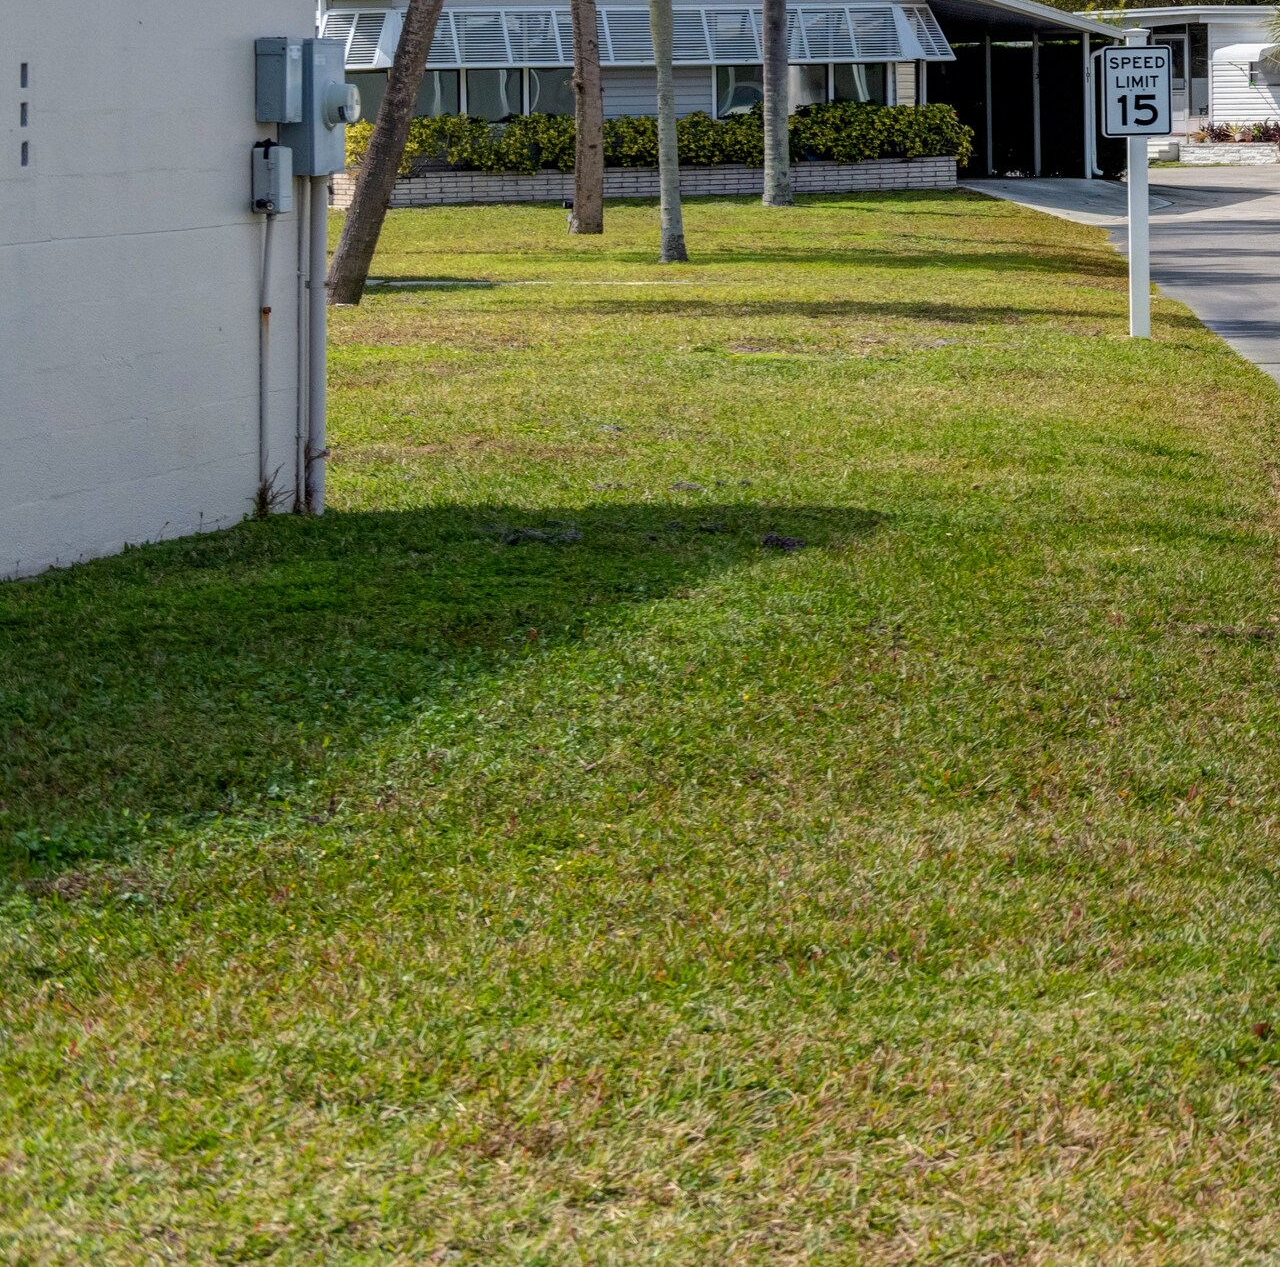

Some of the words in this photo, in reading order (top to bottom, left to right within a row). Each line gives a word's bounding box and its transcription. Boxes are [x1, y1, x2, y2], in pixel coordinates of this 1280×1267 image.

[1109, 56, 1165, 69] SPEED
[1116, 75, 1159, 88] LIMIT
[1117, 94, 1159, 126] 15
